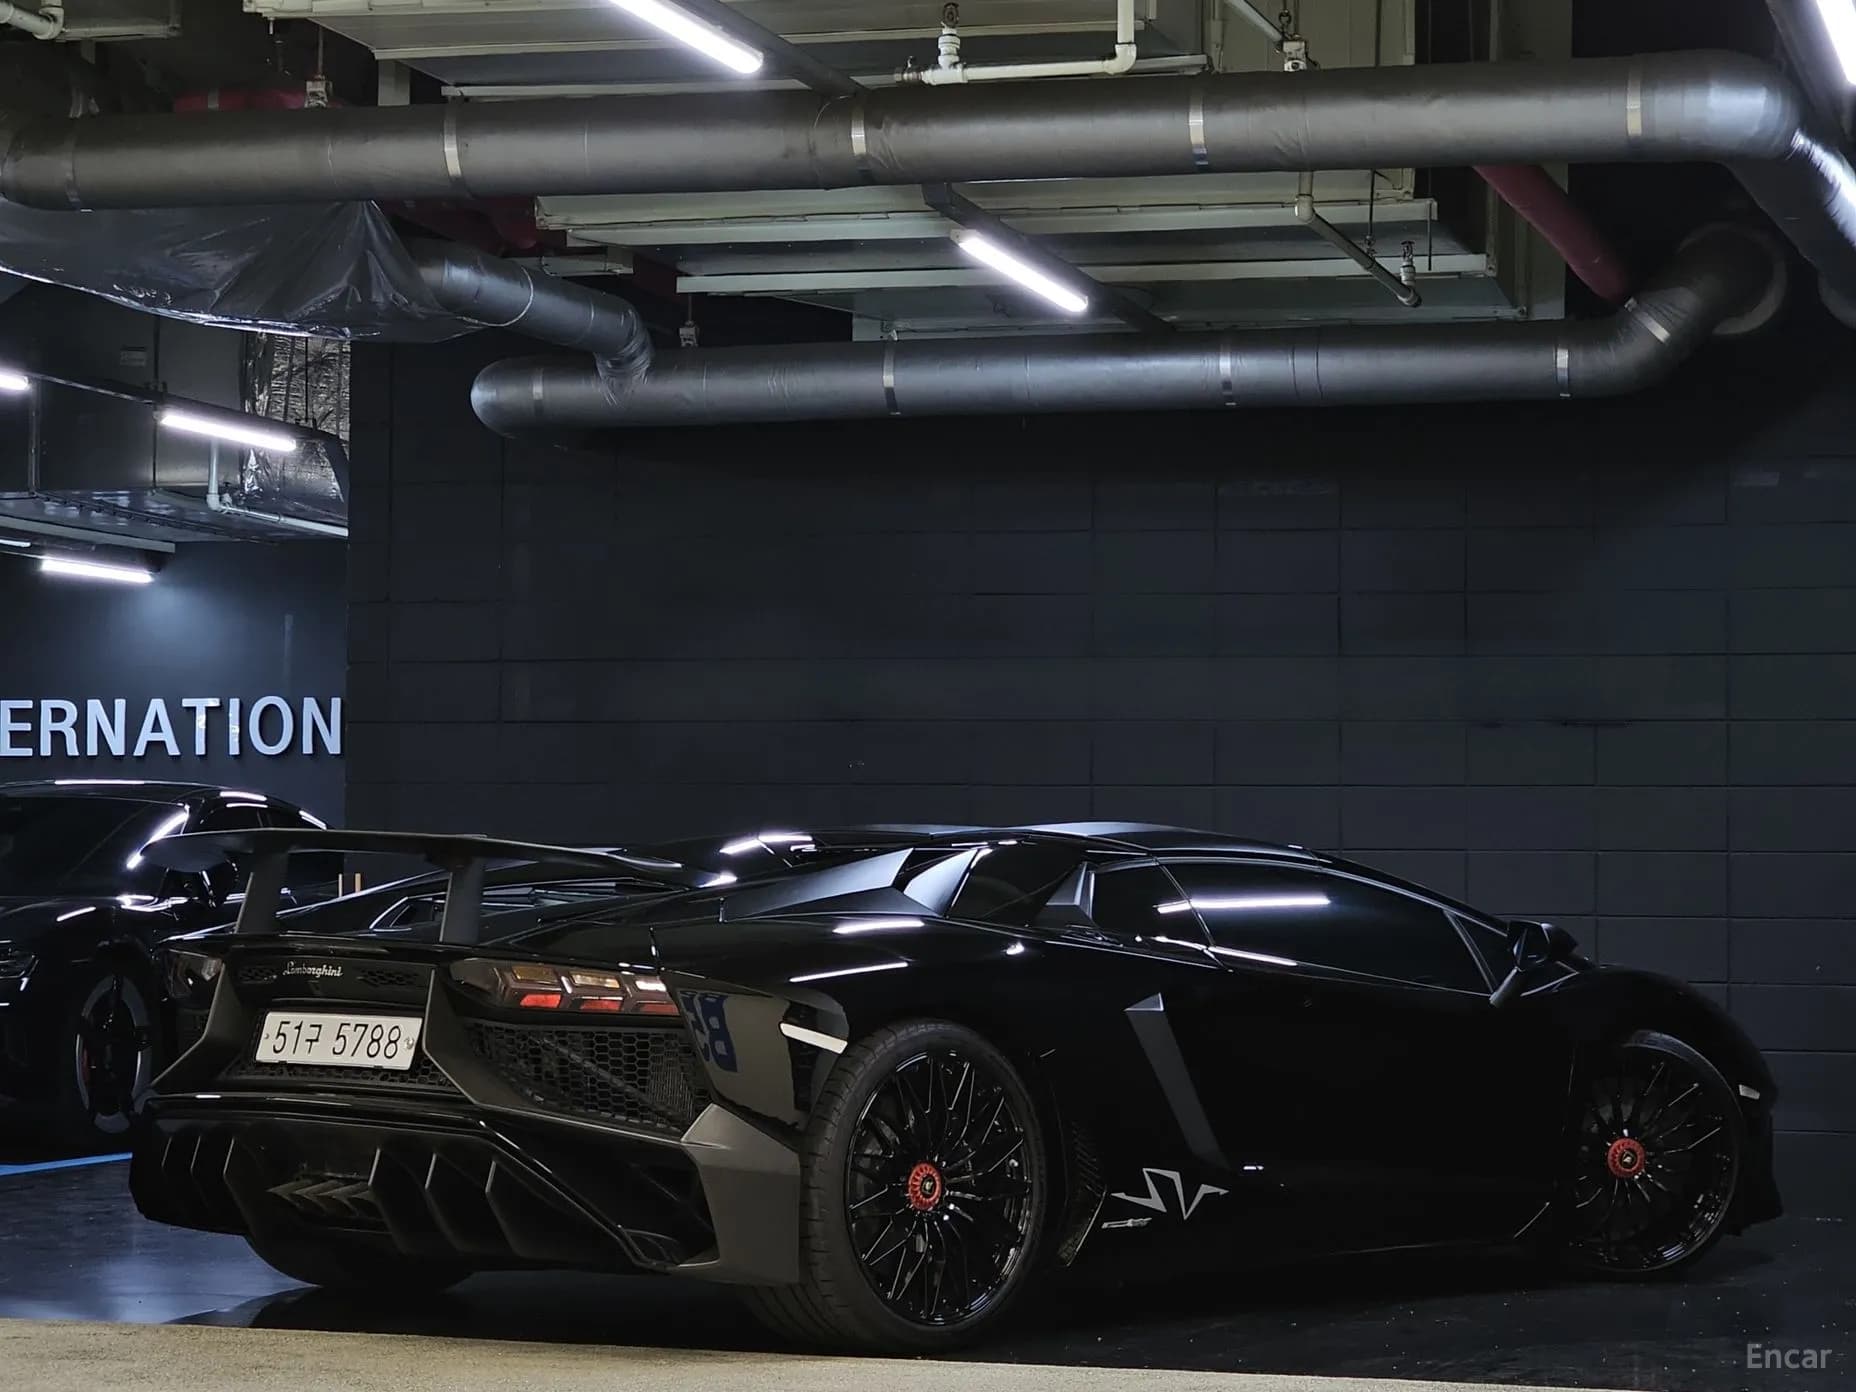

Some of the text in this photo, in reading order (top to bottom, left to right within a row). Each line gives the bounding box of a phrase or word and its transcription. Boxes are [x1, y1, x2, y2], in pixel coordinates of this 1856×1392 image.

[0, 696, 341, 756] ERNATION
[282, 961, 344, 979] Lamborghini
[272, 1020, 402, 1060] 51구 5788
